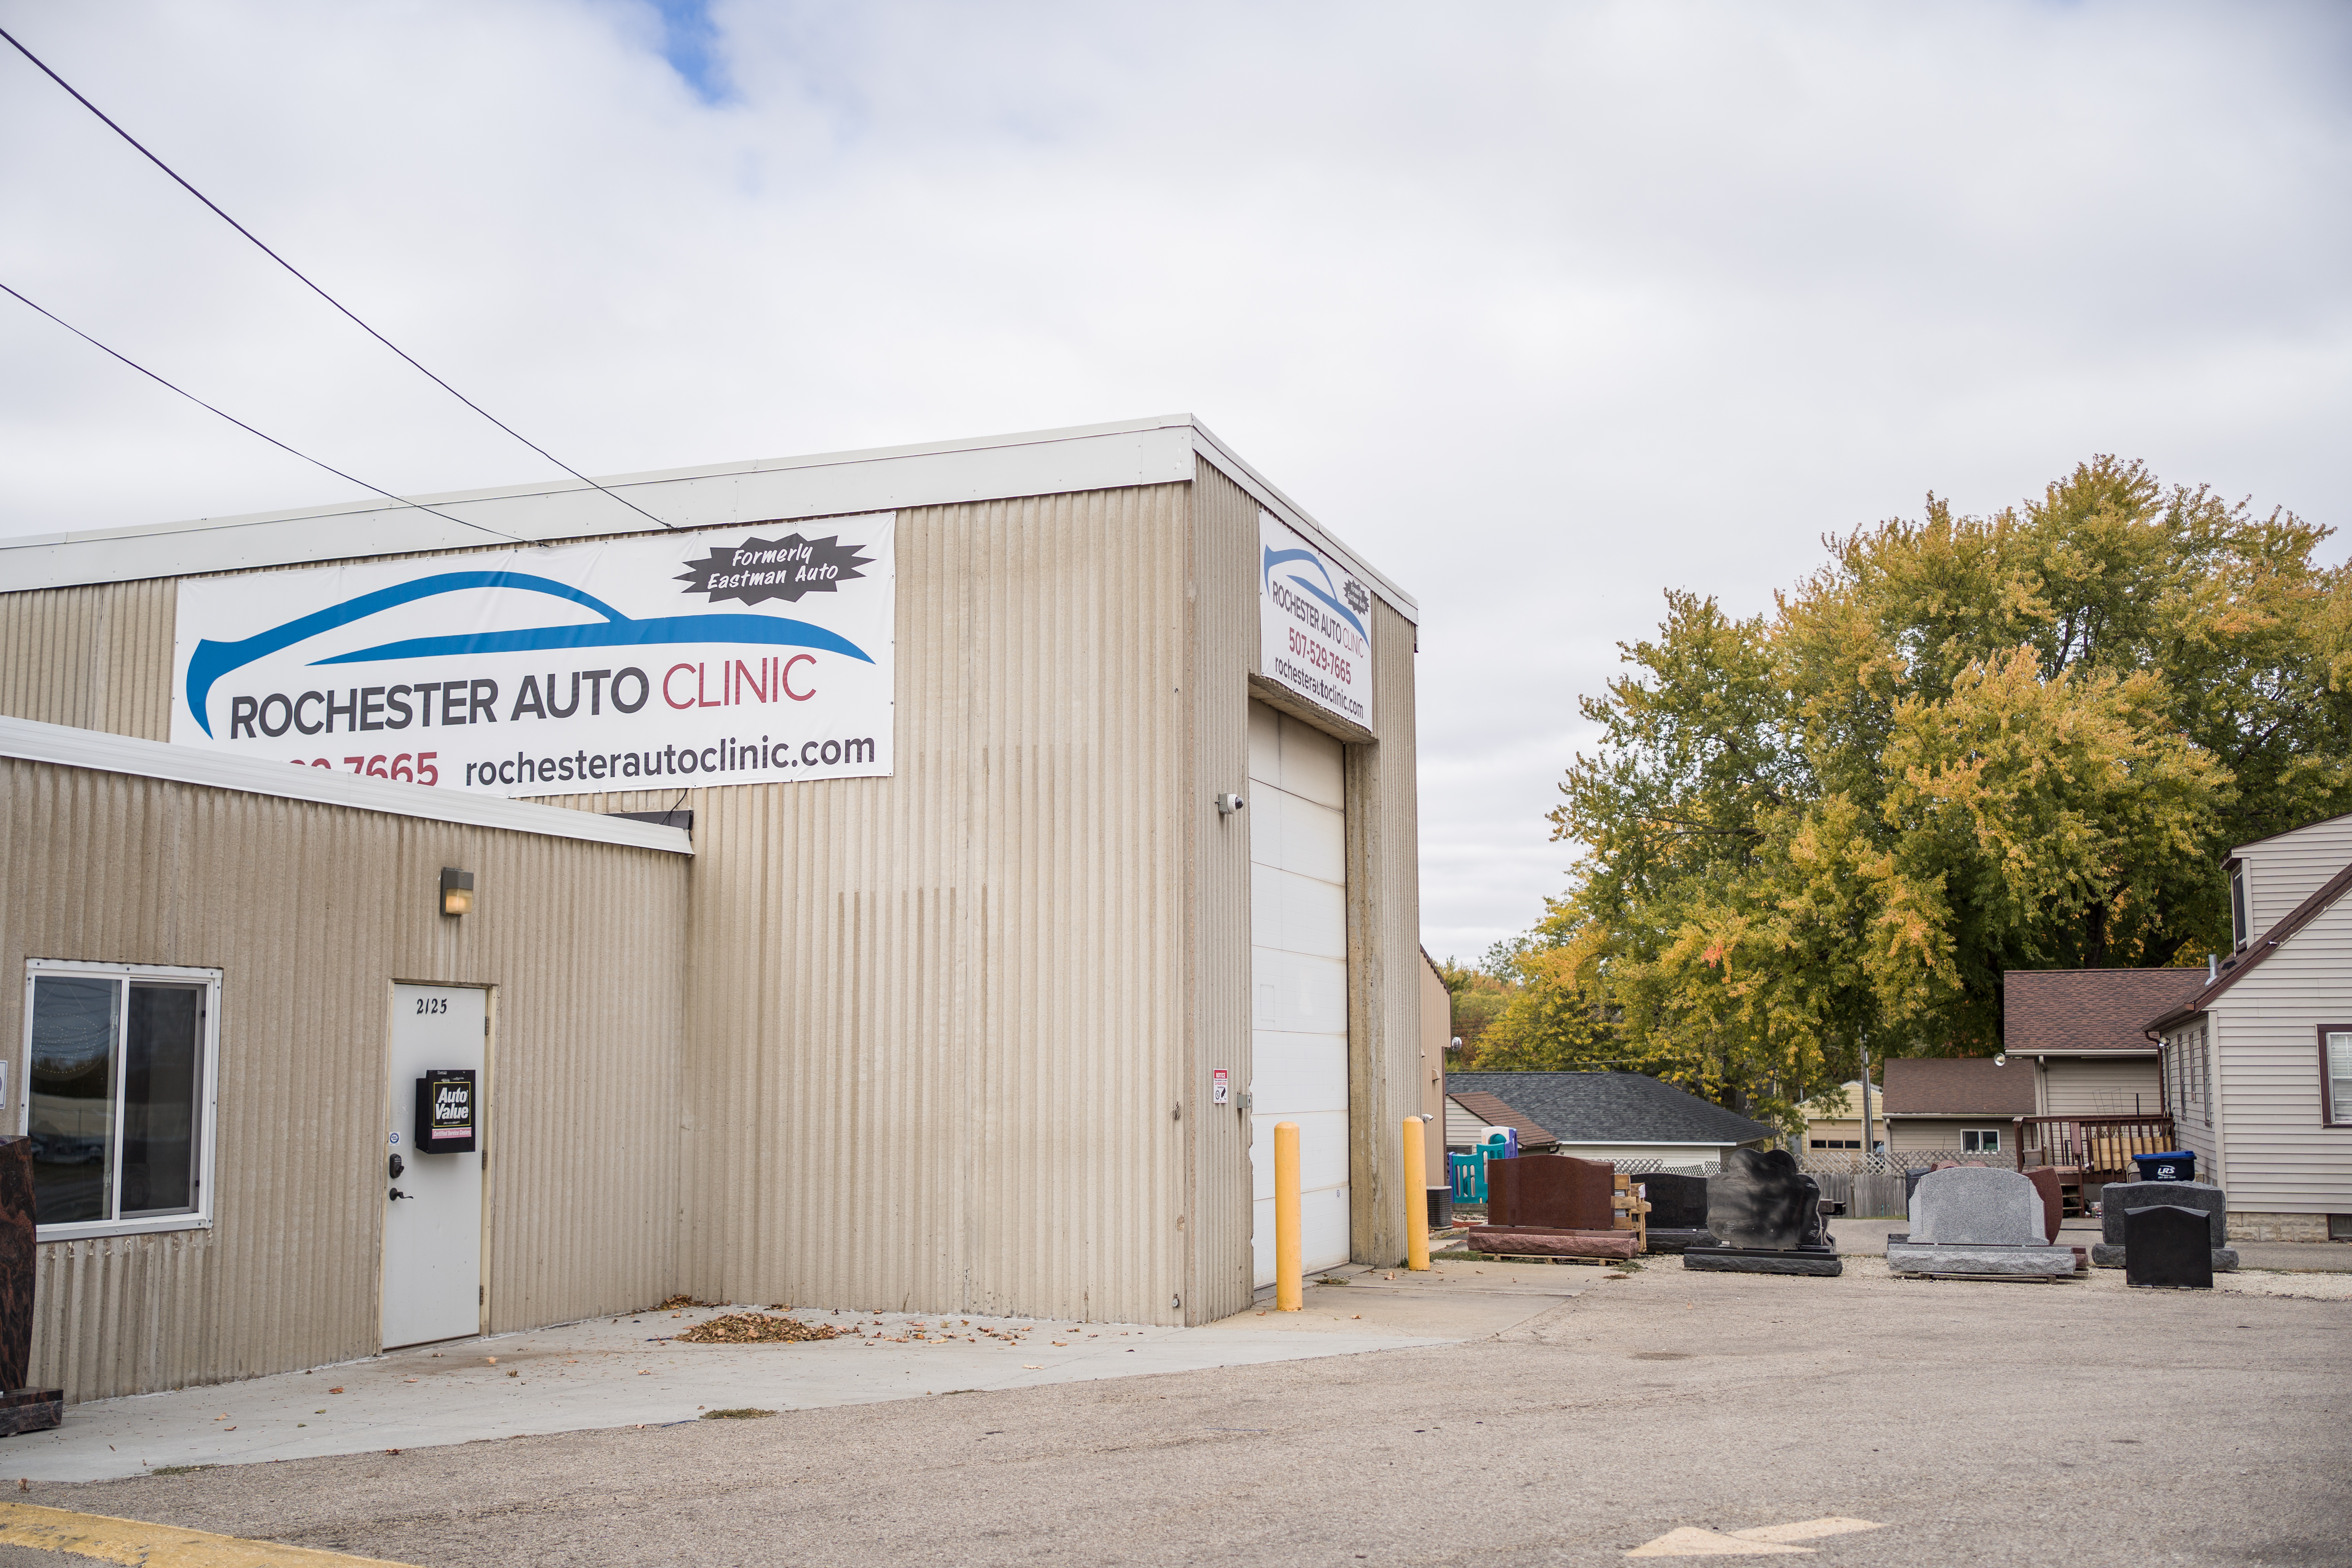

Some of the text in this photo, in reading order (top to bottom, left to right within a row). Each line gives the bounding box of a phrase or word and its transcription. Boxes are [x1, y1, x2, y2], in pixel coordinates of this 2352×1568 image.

[732, 543, 814, 566] Formerly
[707, 563, 838, 590] Eastman Auto
[1351, 584, 1362, 600] Formerly
[1273, 580, 1364, 659] ROCHESTER AUTO CLINIC
[1289, 626, 1351, 685] 507-529-7665
[231, 654, 817, 740] ROCHESTER AUTO CLINIC
[1275, 656, 1363, 719] rochesterautoclinic.com
[290, 735, 874, 787] 7665 rochesterautoclinic.com
[416, 998, 447, 1014] 2125
[437, 1087, 467, 1103] Auto
[435, 1103, 469, 1120] Value
